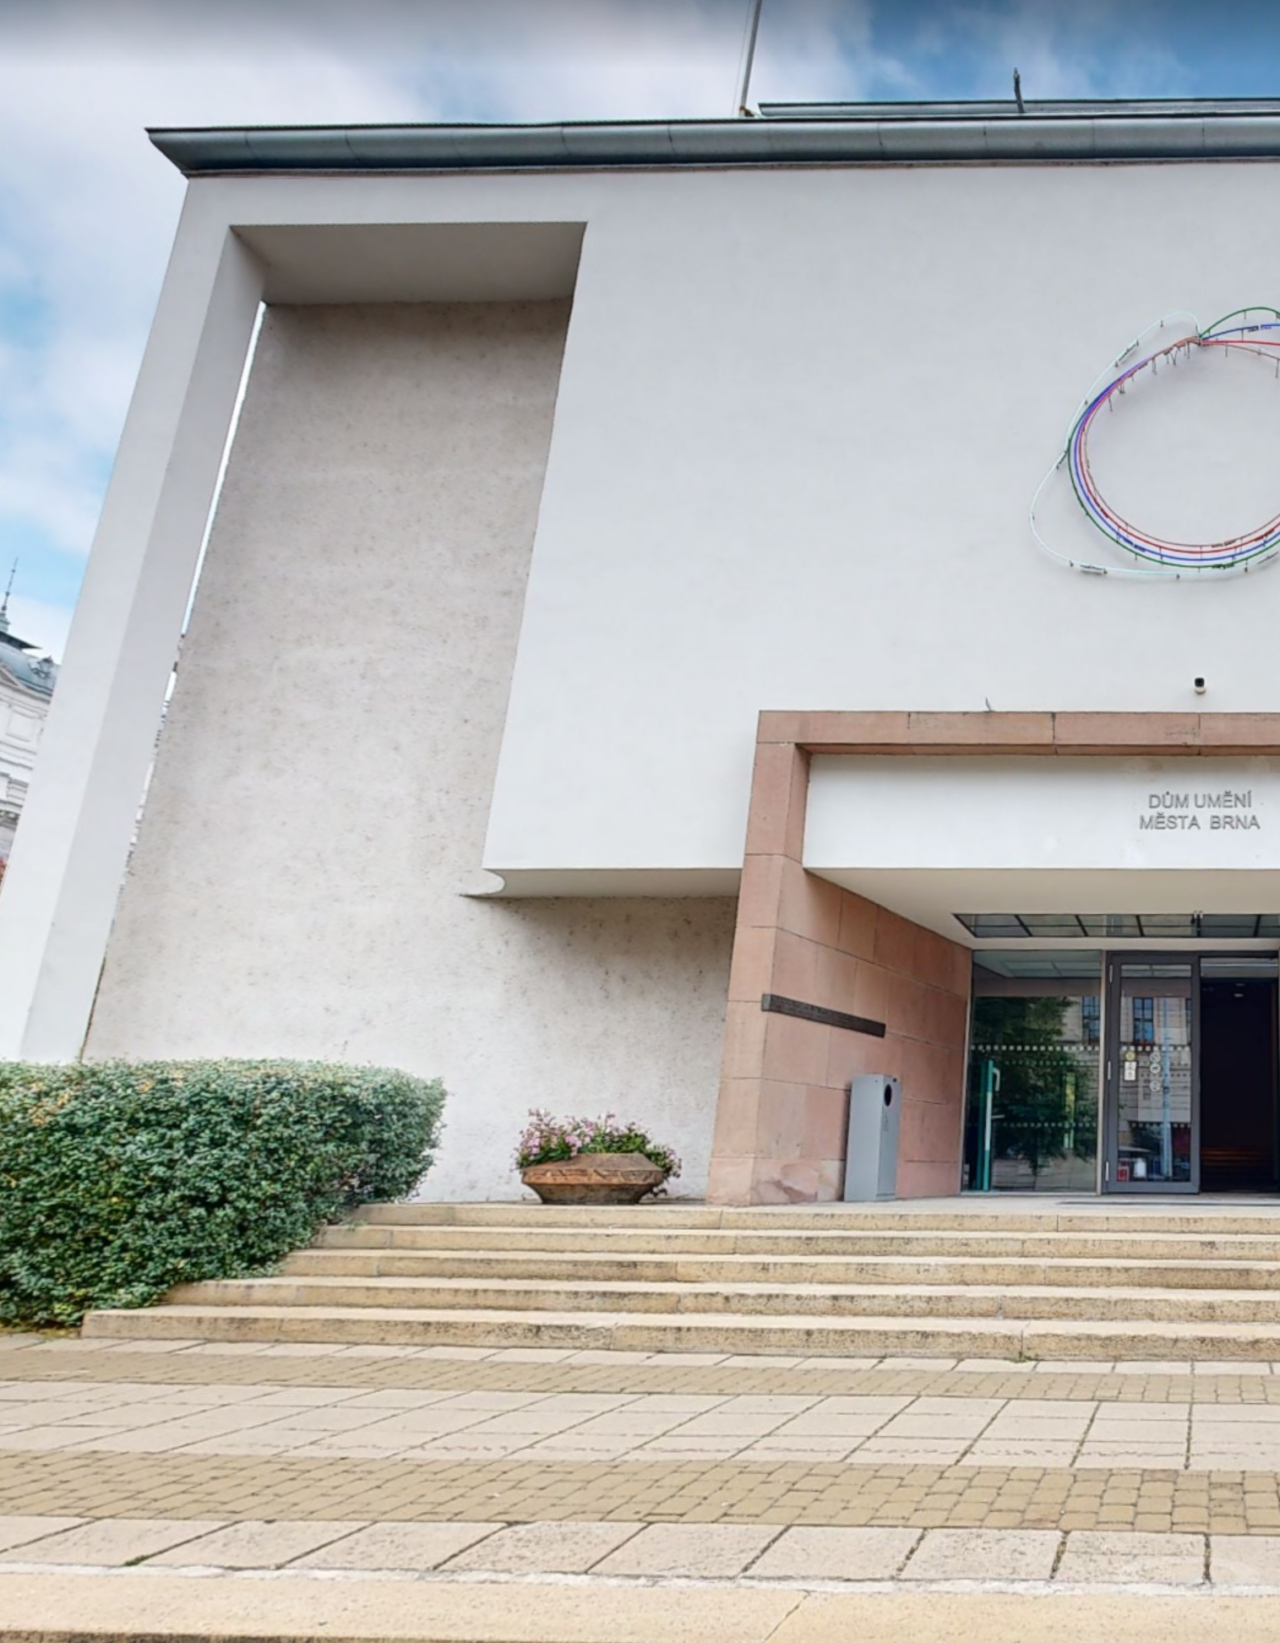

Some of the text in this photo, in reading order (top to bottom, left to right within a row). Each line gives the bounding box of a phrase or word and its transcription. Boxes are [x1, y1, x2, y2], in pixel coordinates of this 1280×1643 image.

[1148, 790, 1252, 809] DŮM UMĚNÍ
[1139, 812, 1261, 830] MĚSTA BRNA
